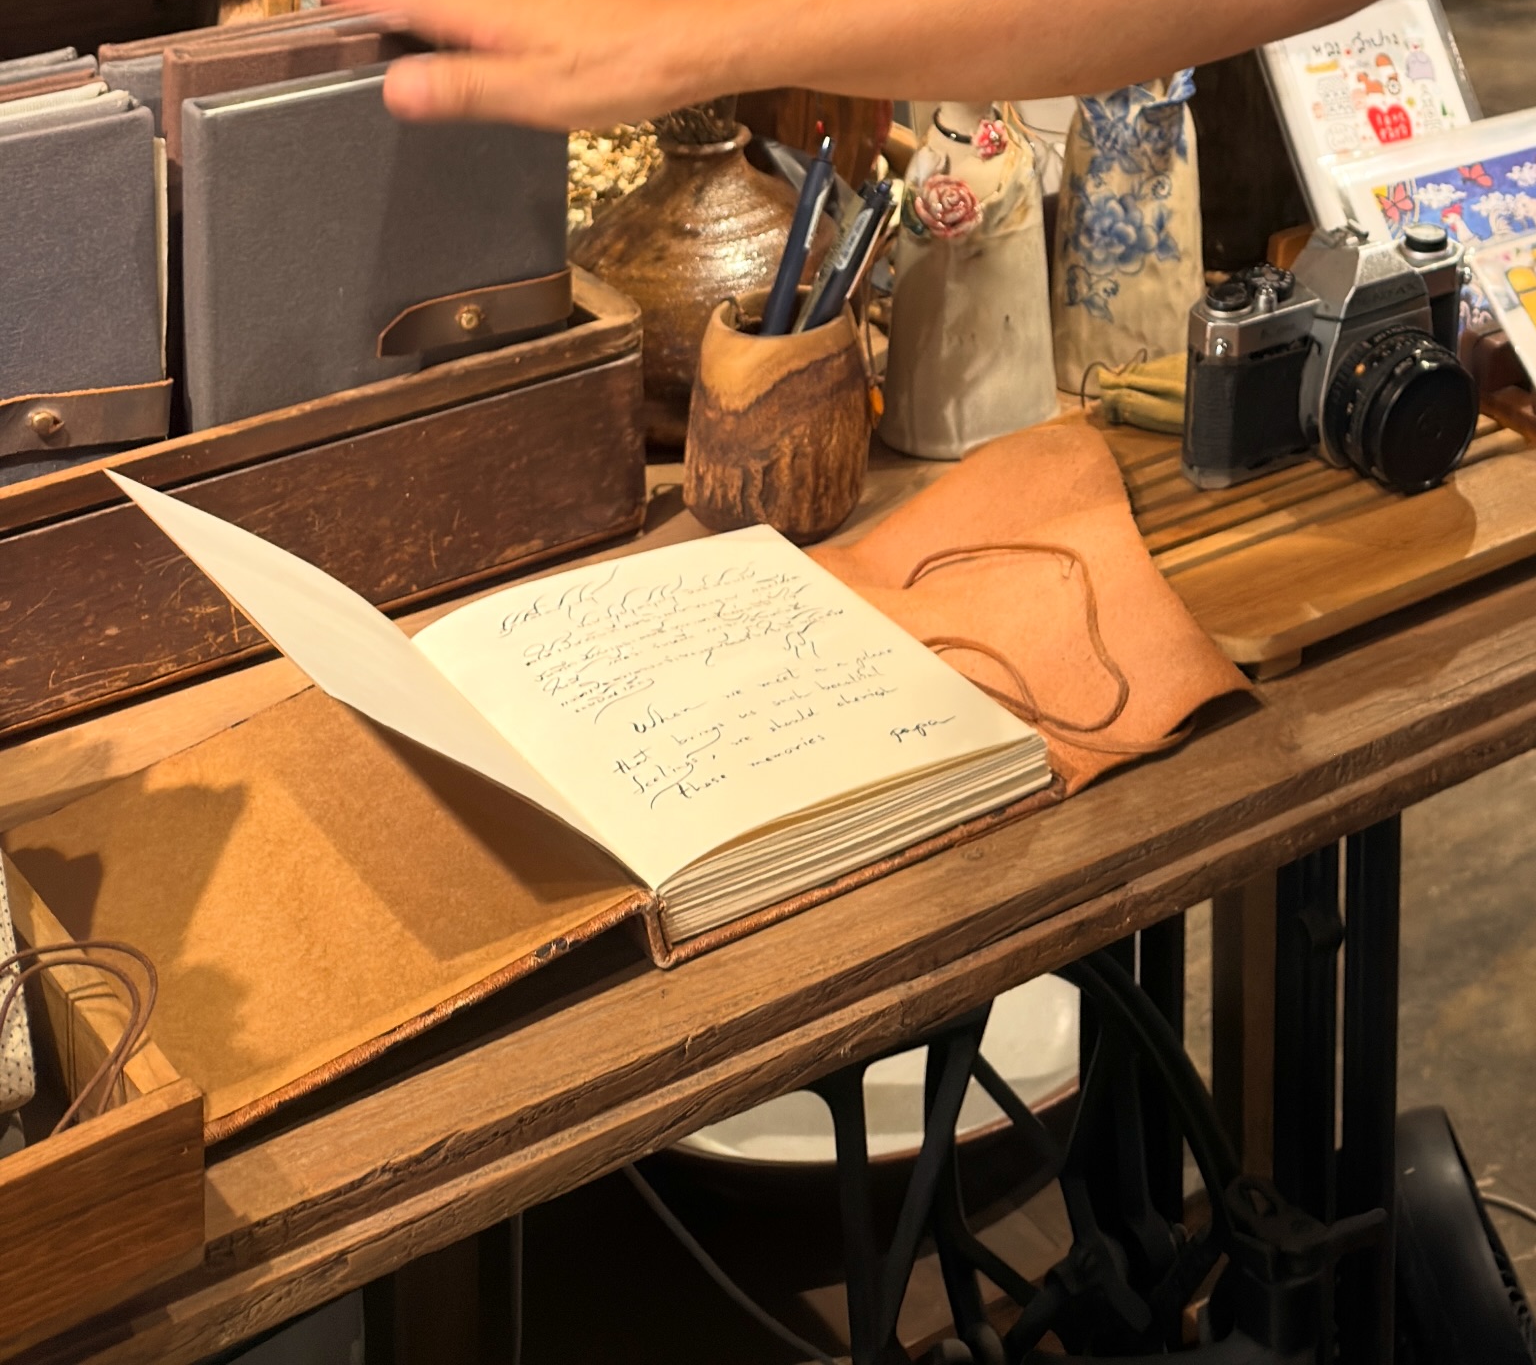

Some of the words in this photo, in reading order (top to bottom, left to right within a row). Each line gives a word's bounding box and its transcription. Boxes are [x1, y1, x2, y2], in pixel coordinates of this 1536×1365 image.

[630, 702, 707, 734] When
[769, 706, 818, 733] should
[613, 746, 652, 774] that
[676, 773, 727, 800] these
[749, 733, 826, 769] memories
